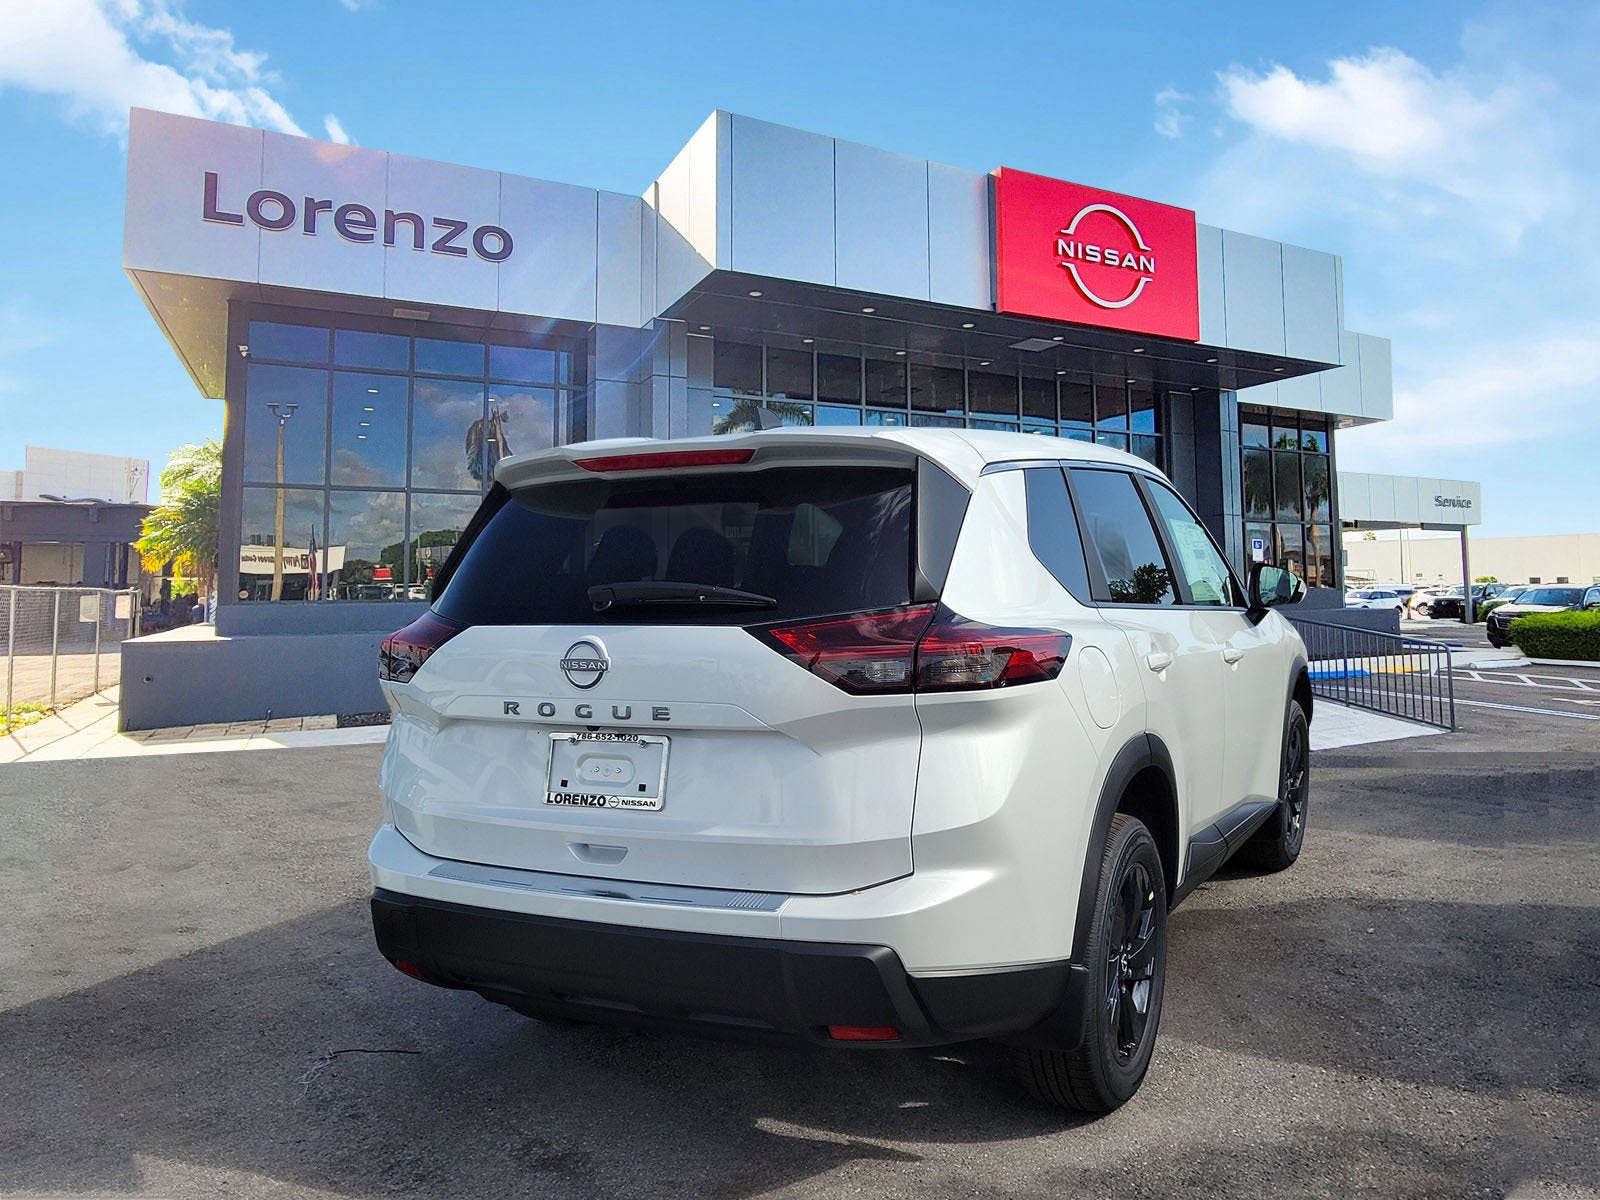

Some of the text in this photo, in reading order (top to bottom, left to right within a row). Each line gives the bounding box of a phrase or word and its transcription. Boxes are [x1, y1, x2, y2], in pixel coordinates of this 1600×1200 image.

[203, 171, 514, 262] Lorenzo
[1057, 238, 1155, 273] NISSAN
[1434, 495, 1472, 508] Service
[560, 659, 607, 670] NISSAN
[503, 701, 672, 721] ROGUE
[576, 732, 639, 742] 786-652-1020
[546, 792, 657, 807] LORENZO NISSAN
